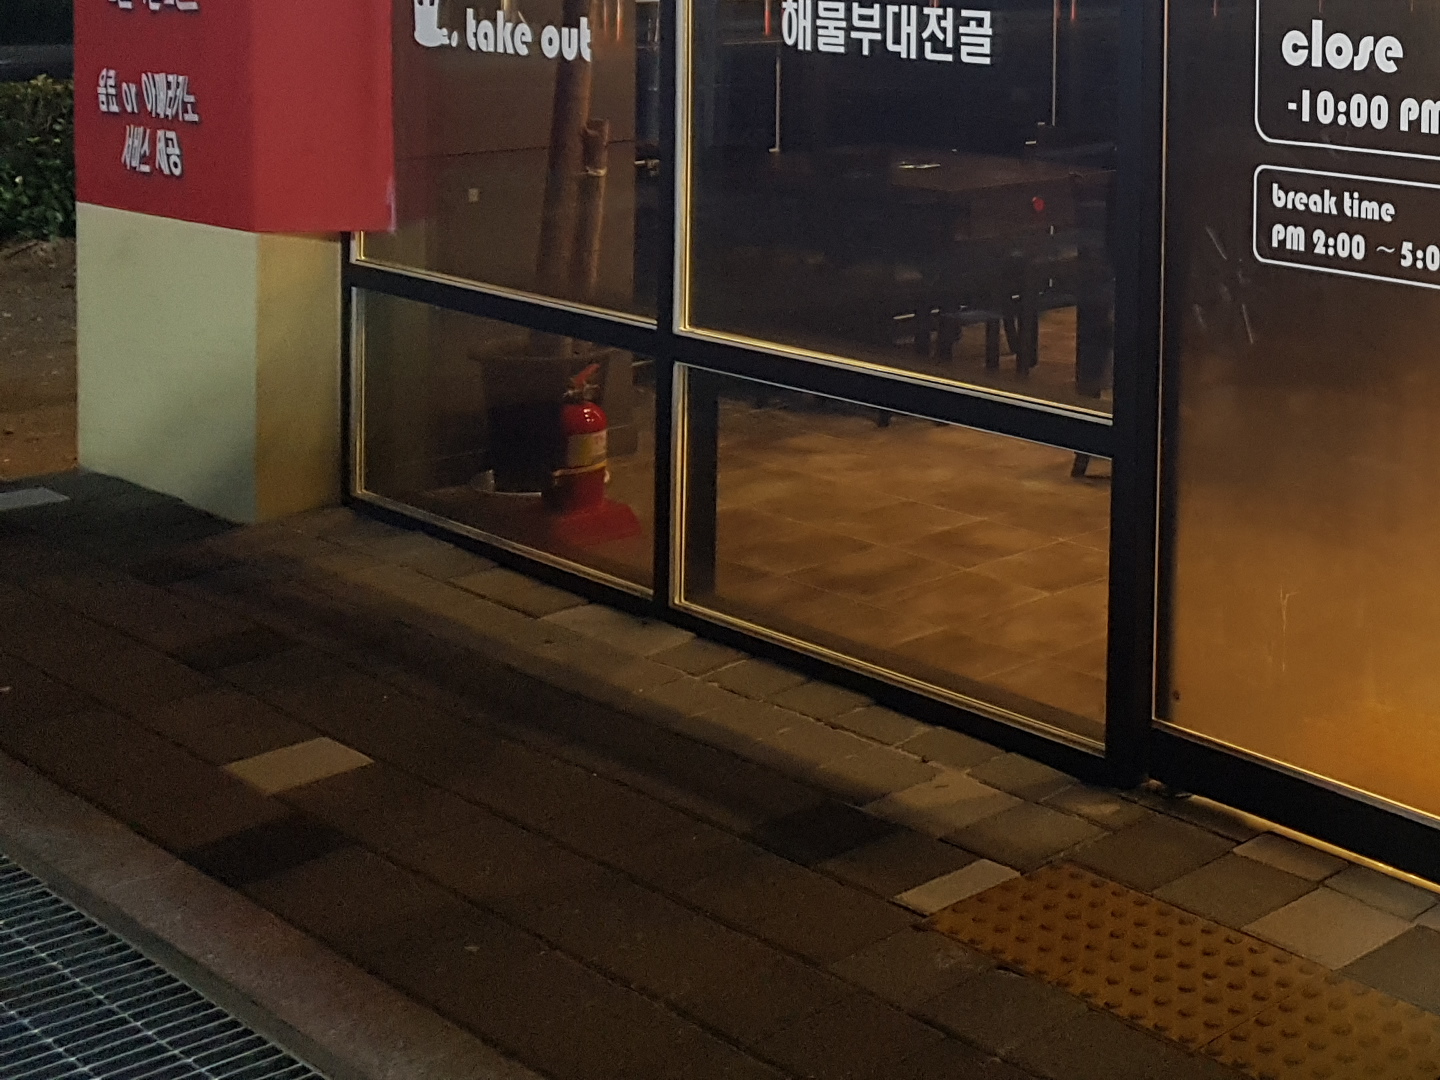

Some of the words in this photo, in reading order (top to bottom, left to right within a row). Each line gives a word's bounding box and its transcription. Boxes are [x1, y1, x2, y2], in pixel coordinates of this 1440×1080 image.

[466, 8, 533, 56] take
[540, 16, 592, 62] out
[1281, 19, 1404, 74] close
[97, 68, 120, 113] 음료
[121, 82, 138, 114] or
[1272, 183, 1338, 216] break
[1343, 191, 1395, 222] time
[1271, 224, 1305, 252] PM
[1312, 229, 1365, 260] 2:00
